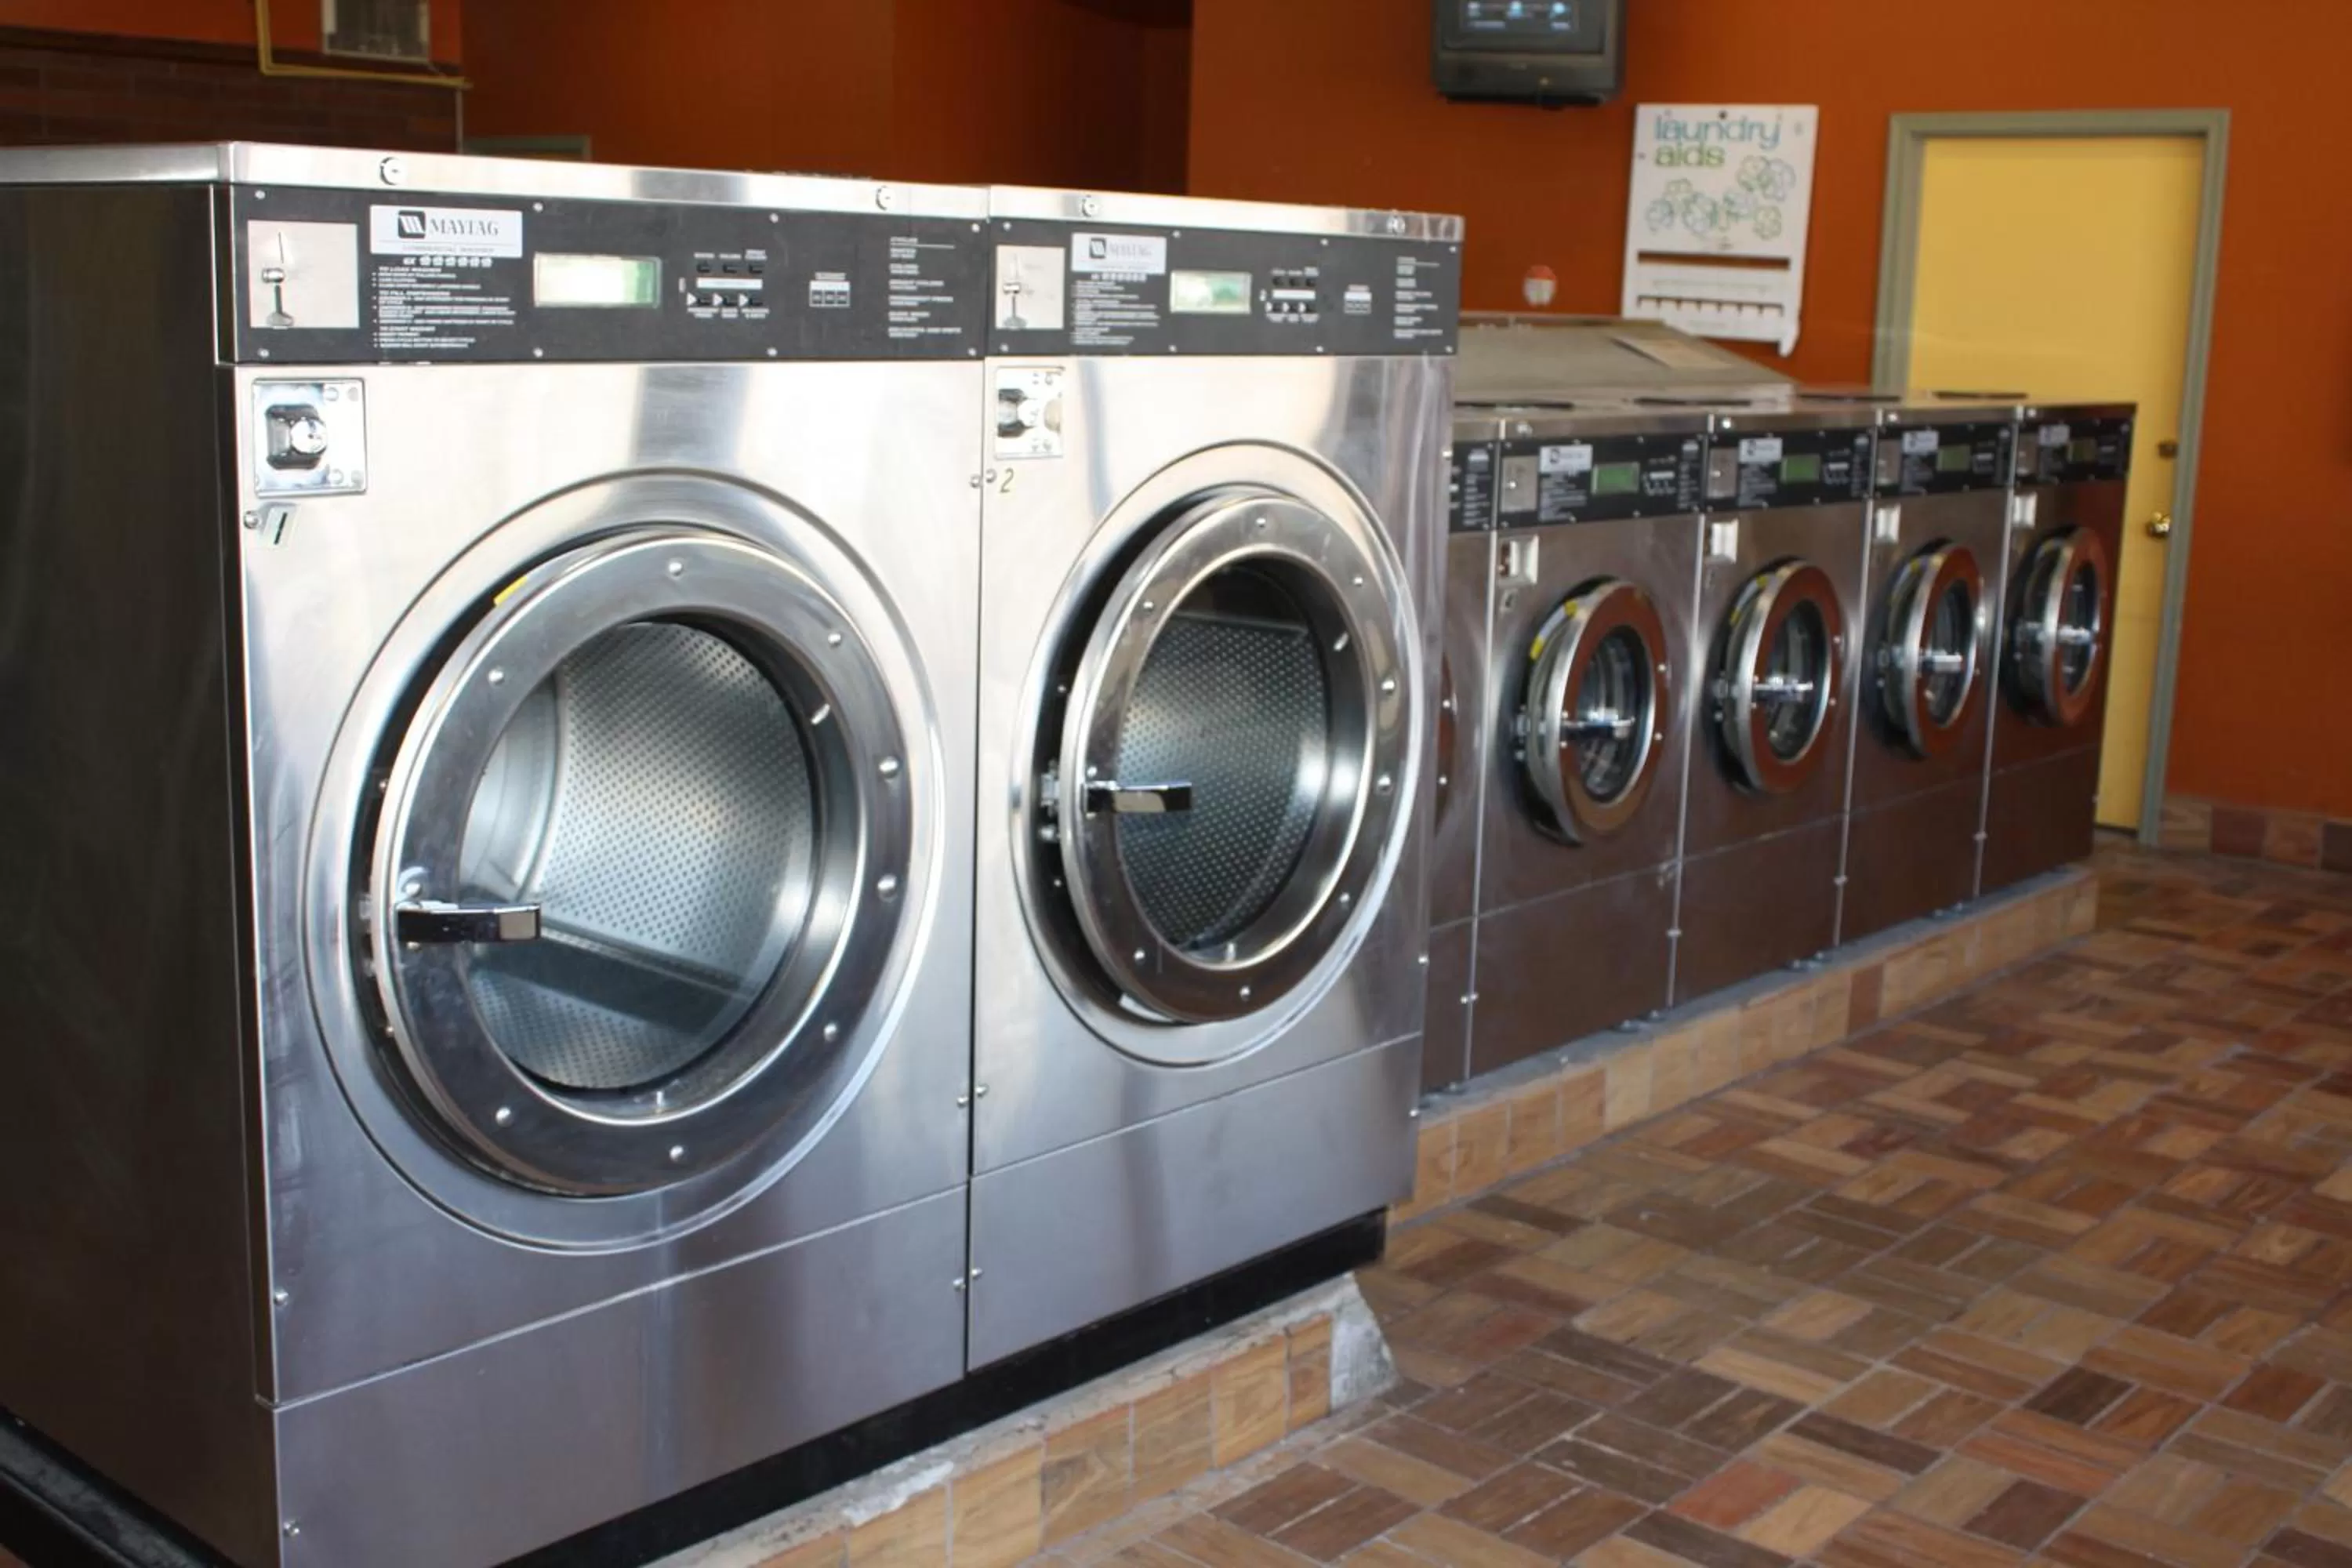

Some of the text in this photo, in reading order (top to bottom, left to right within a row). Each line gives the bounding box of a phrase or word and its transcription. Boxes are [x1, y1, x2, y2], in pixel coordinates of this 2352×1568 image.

[1655, 116, 1781, 150] laundry
[1655, 144, 1725, 166] aids
[430, 218, 499, 236] MAYTAG
[1000, 467, 1014, 493] 2
